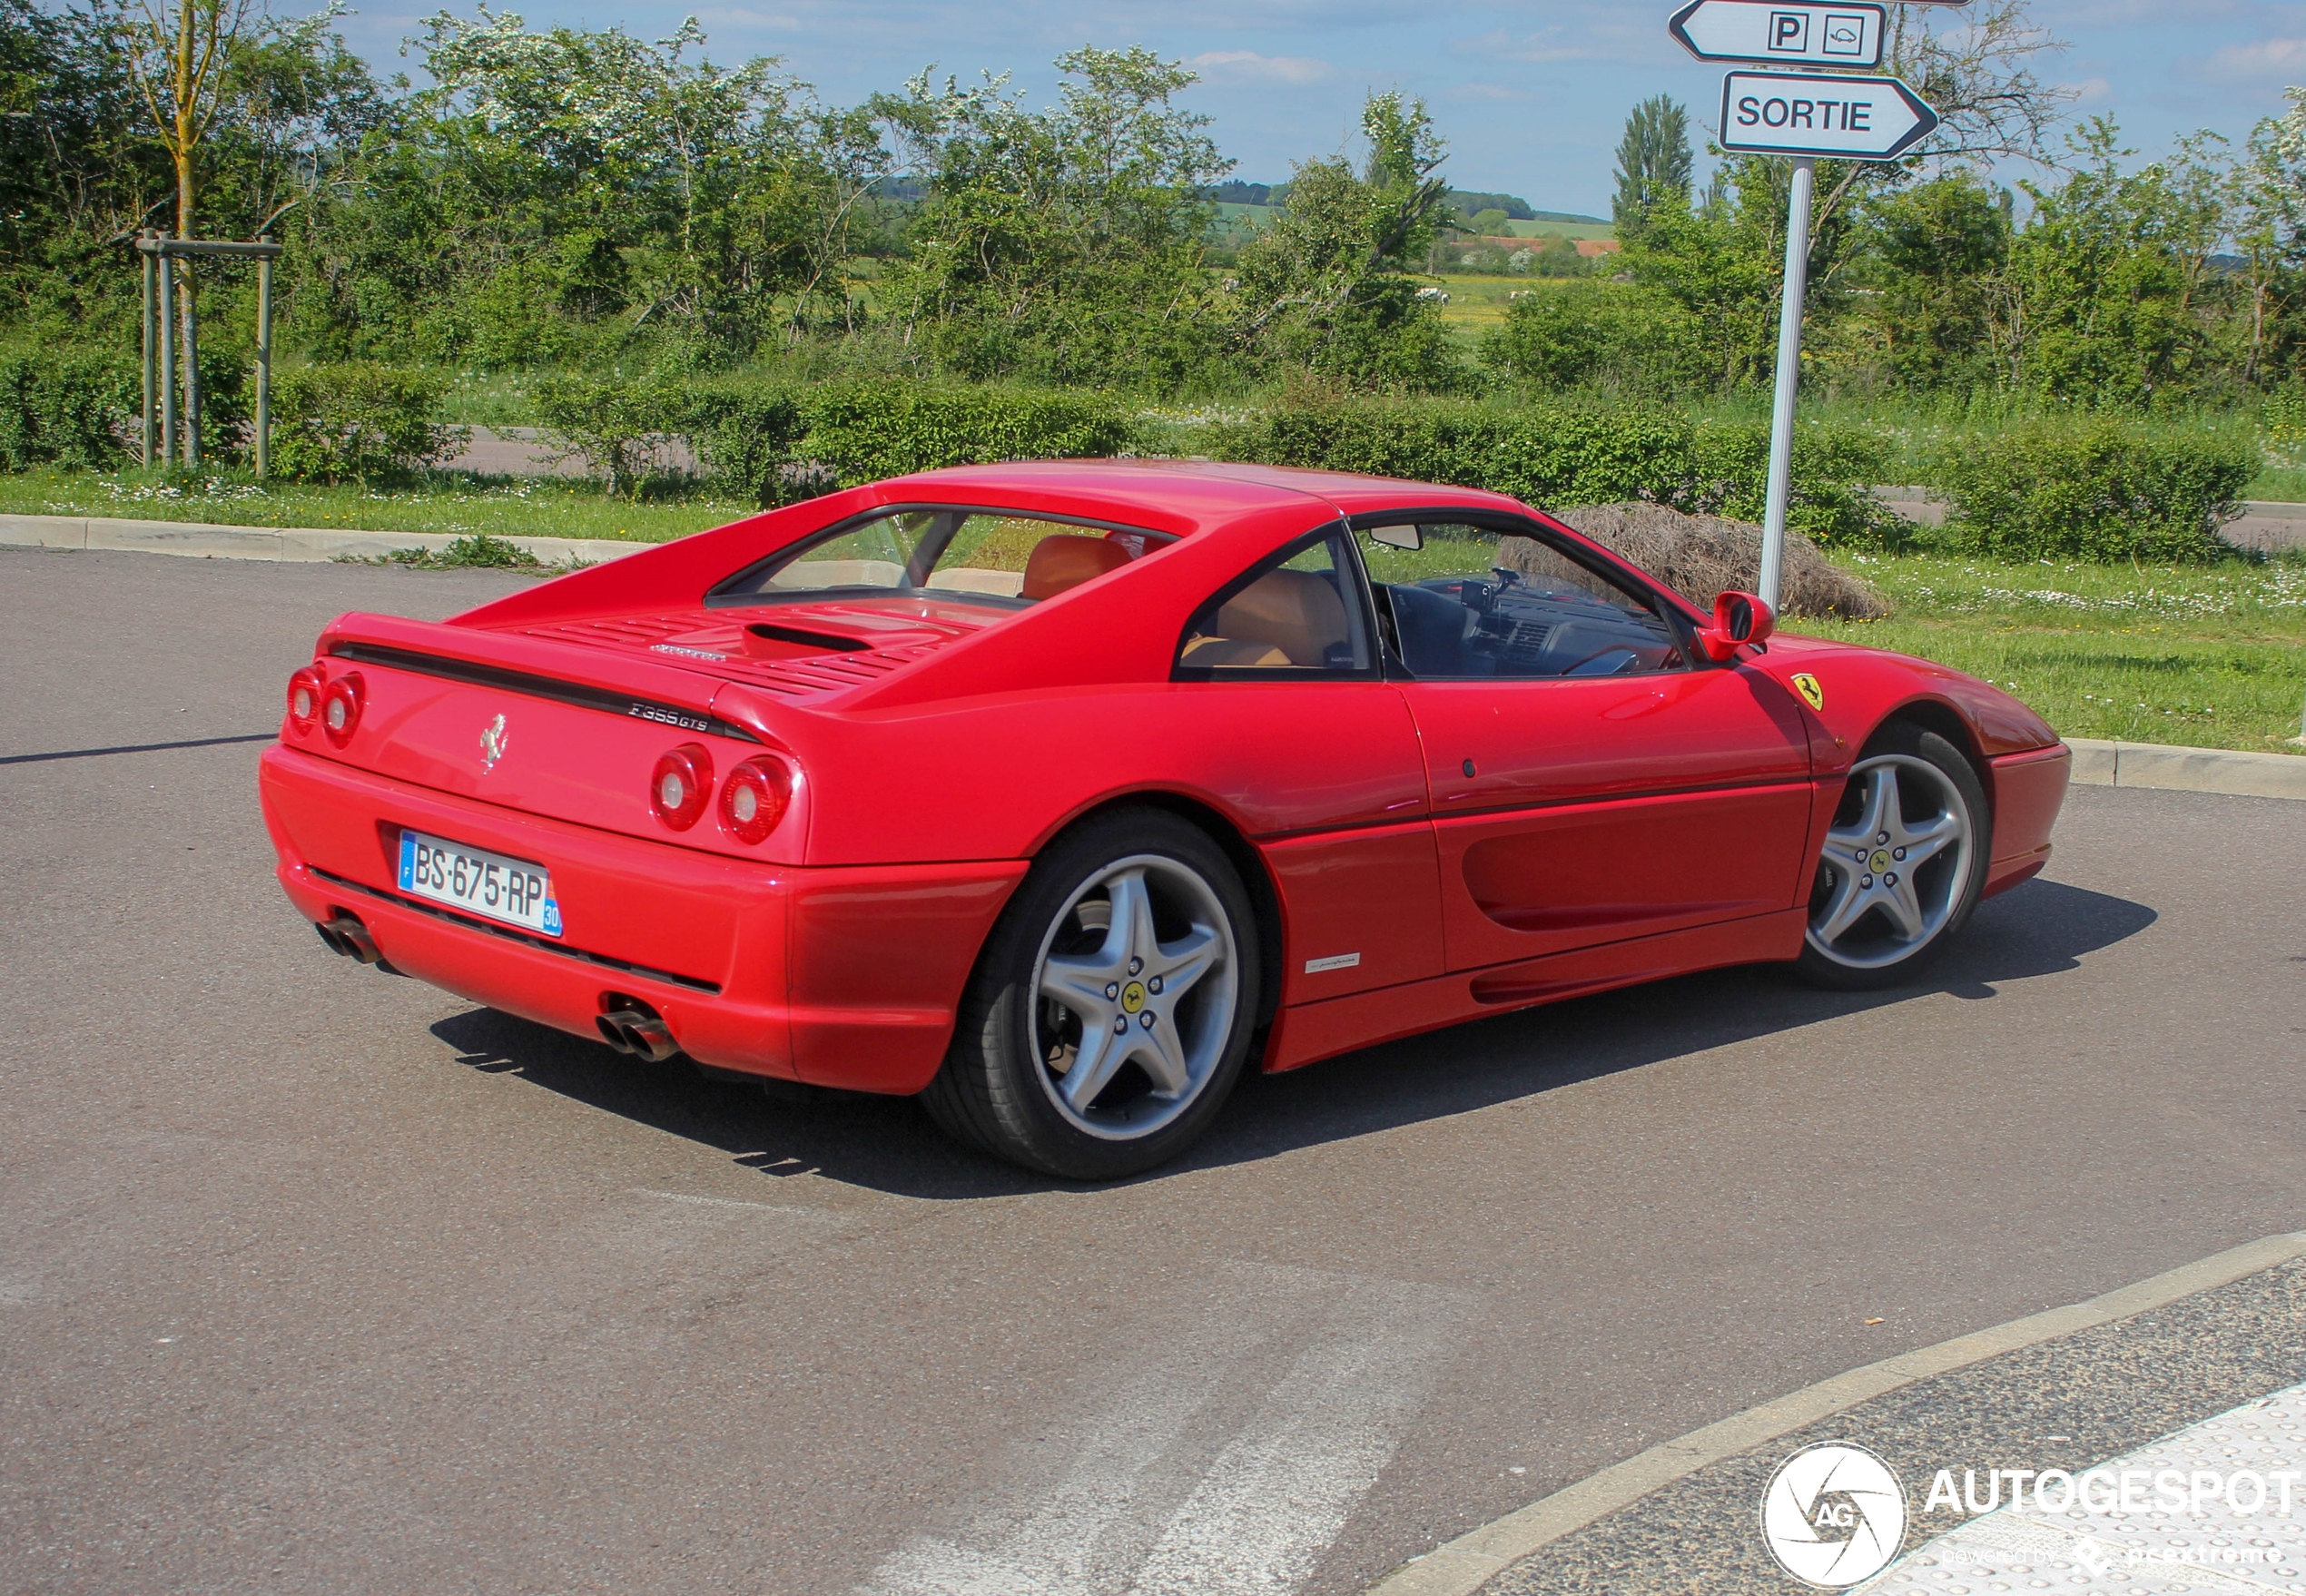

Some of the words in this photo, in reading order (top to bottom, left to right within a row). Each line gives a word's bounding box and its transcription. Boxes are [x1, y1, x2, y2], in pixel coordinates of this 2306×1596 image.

[1777, 16, 1800, 46] P
[1736, 95, 1873, 133] SORTIE
[679, 717, 708, 732] GTS
[403, 867, 410, 878] F
[415, 843, 542, 916] BS-675-RP
[545, 905, 558, 927] 30
